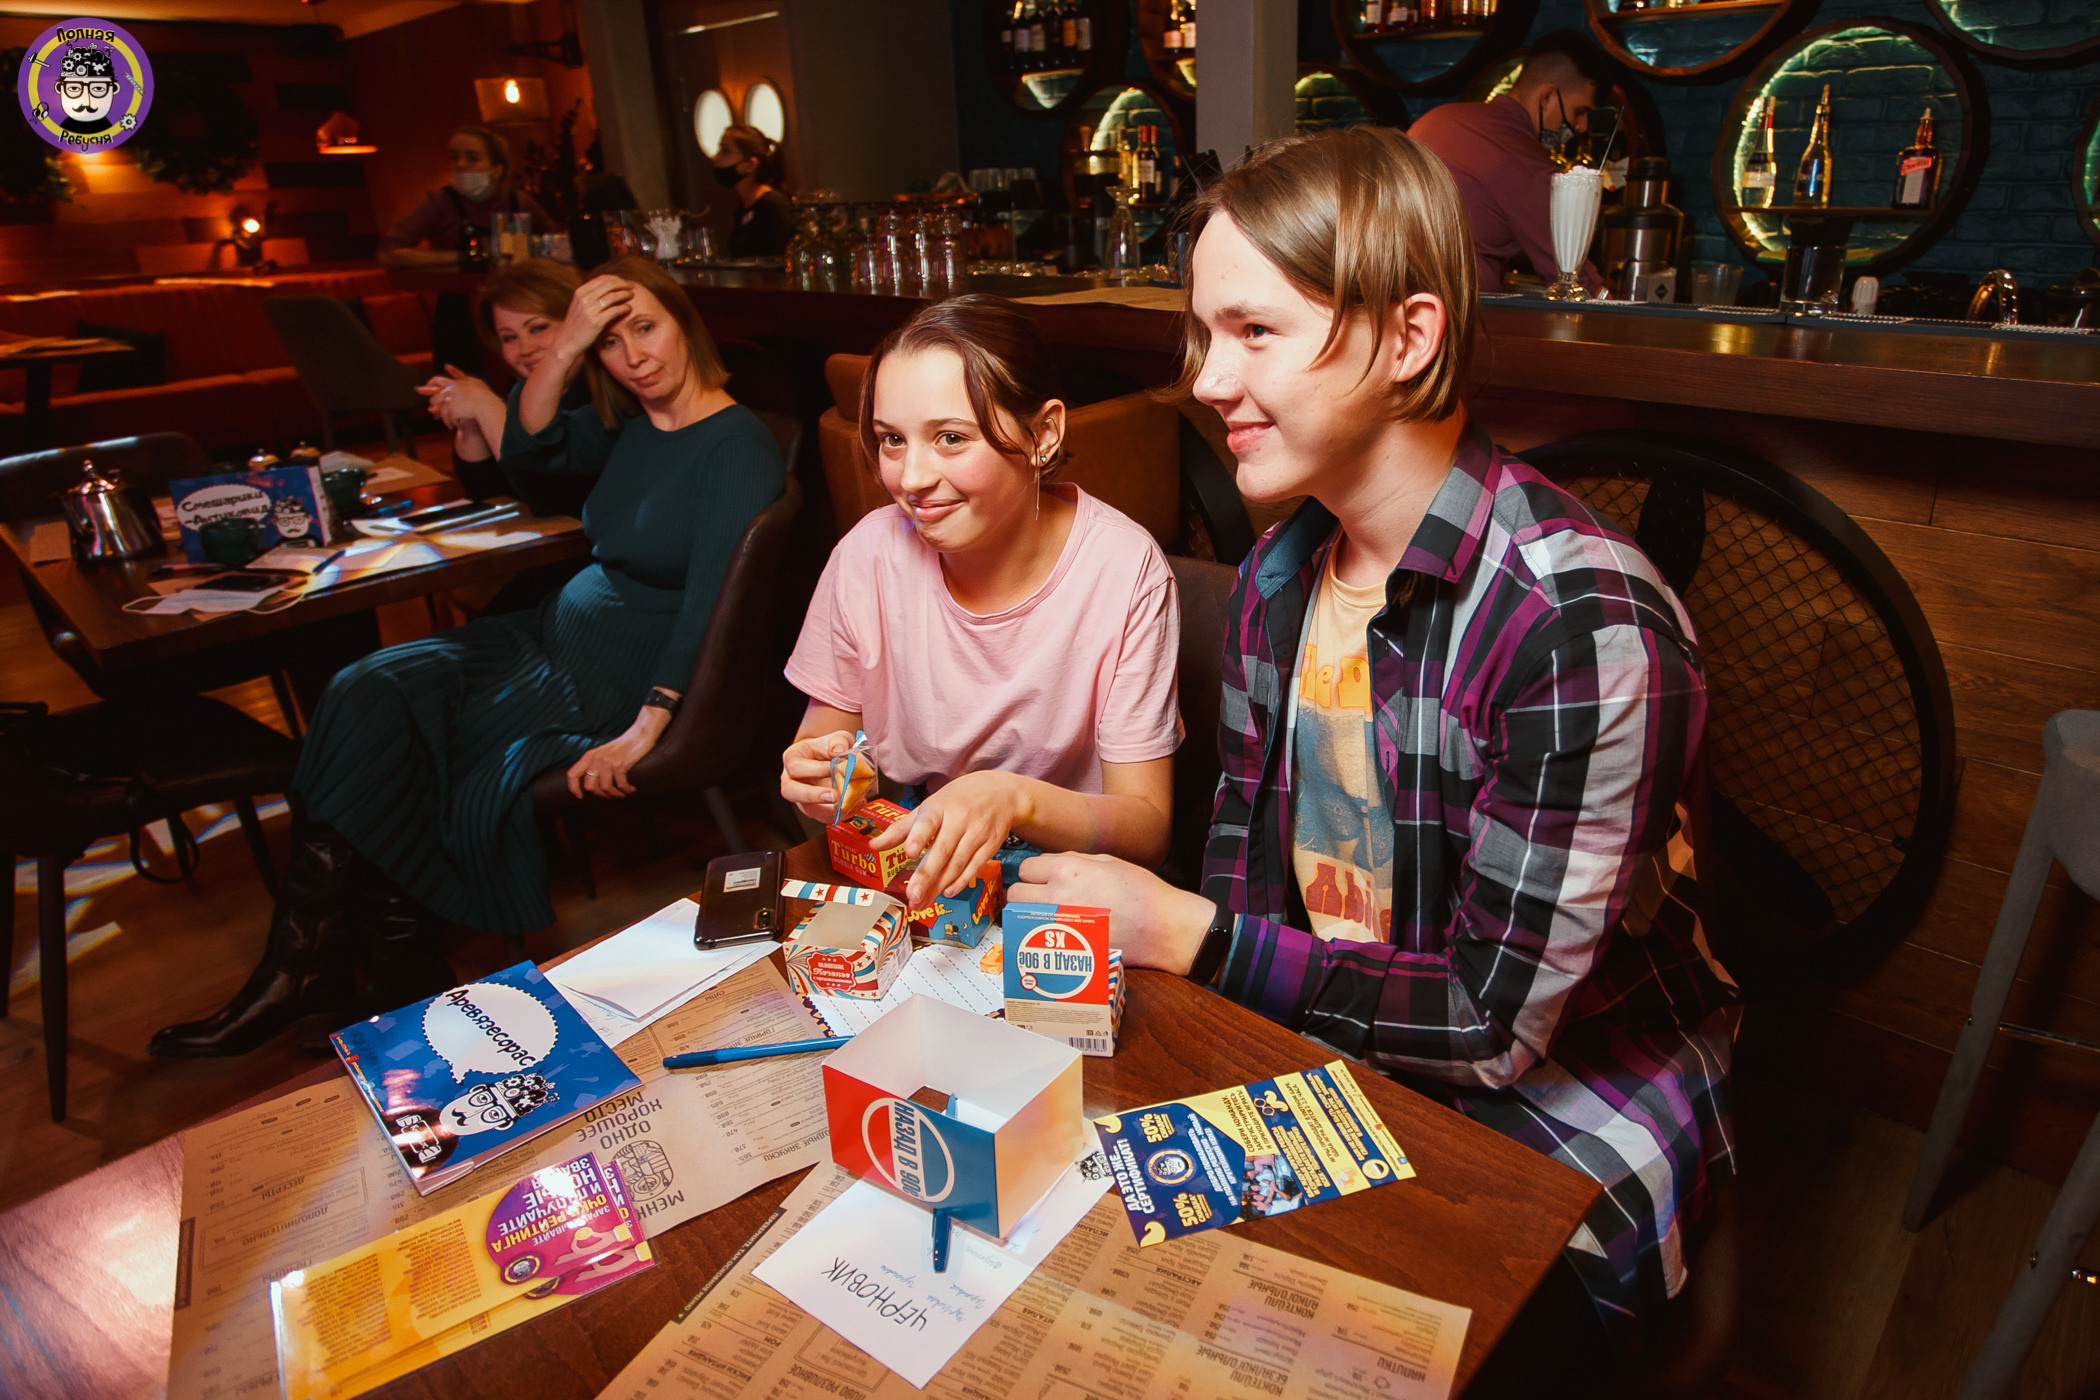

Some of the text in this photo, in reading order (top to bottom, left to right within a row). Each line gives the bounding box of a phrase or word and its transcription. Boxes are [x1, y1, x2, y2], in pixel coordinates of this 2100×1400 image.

[182, 490, 263, 512] Смешарики
[831, 839, 876, 873] Turbo
[1043, 930, 1065, 948] XS
[1018, 951, 1092, 971] НАЗАД В 90е
[703, 989, 725, 1002] СУПЫ
[446, 989, 535, 1067] Аревязесорас
[743, 1027, 775, 1044] ГОРЯЧИЕ
[575, 1097, 662, 1142] ХОРОШЕЕ
[583, 1091, 644, 1124] МЕСТО
[1228, 1092, 1264, 1151] ЗАРЕГИСТРИРУЙТЕСЬ
[598, 1118, 651, 1150] ОДНО
[894, 1102, 918, 1155] НАЗАД
[1137, 1111, 1162, 1144] 50%
[1237, 1126, 1255, 1153] СОБЕРИ
[1247, 1109, 1270, 1144] ПРИХОДИТЕ
[762, 1142, 800, 1161] ЗАКУСКИ
[899, 1155, 916, 1170] В
[260, 1176, 305, 1199] ДЕСЕРТЫ
[589, 1181, 601, 1194] И
[1105, 1144, 1141, 1213] ДА ЭТО ЖЕ...
[1115, 1136, 1155, 1215] СЕРТИФИКАТ!
[241, 1205, 329, 1245] ДОПОЛНИТЕЛЬНО
[497, 1186, 586, 1235] ПЛУЧАЙТЕ
[1171, 1191, 1198, 1228] 50%
[490, 1210, 566, 1253] РЕЙТИНГА
[1075, 1222, 1108, 1237] ИСПАНИ
[1155, 1266, 1201, 1286] АВСТРАЛИЯ
[821, 1256, 930, 1332] ЧЕРНОВИК
[1247, 1279, 1319, 1310] АЛКОГОЛЬНЫЕ
[1263, 1295, 1314, 1320] КОКТЕЙЛИ
[1021, 1306, 1055, 1324] ИТАЛИЯ
[786, 1362, 840, 1394] РАЗЛИВНОЕ
[1195, 1345, 1287, 1384] БЕЗАЛКОГОЛЬНЫЕ
[1376, 1356, 1426, 1382] НАПИТКИ
[1229, 1369, 1283, 1395] КОКТЕЙЛИ
